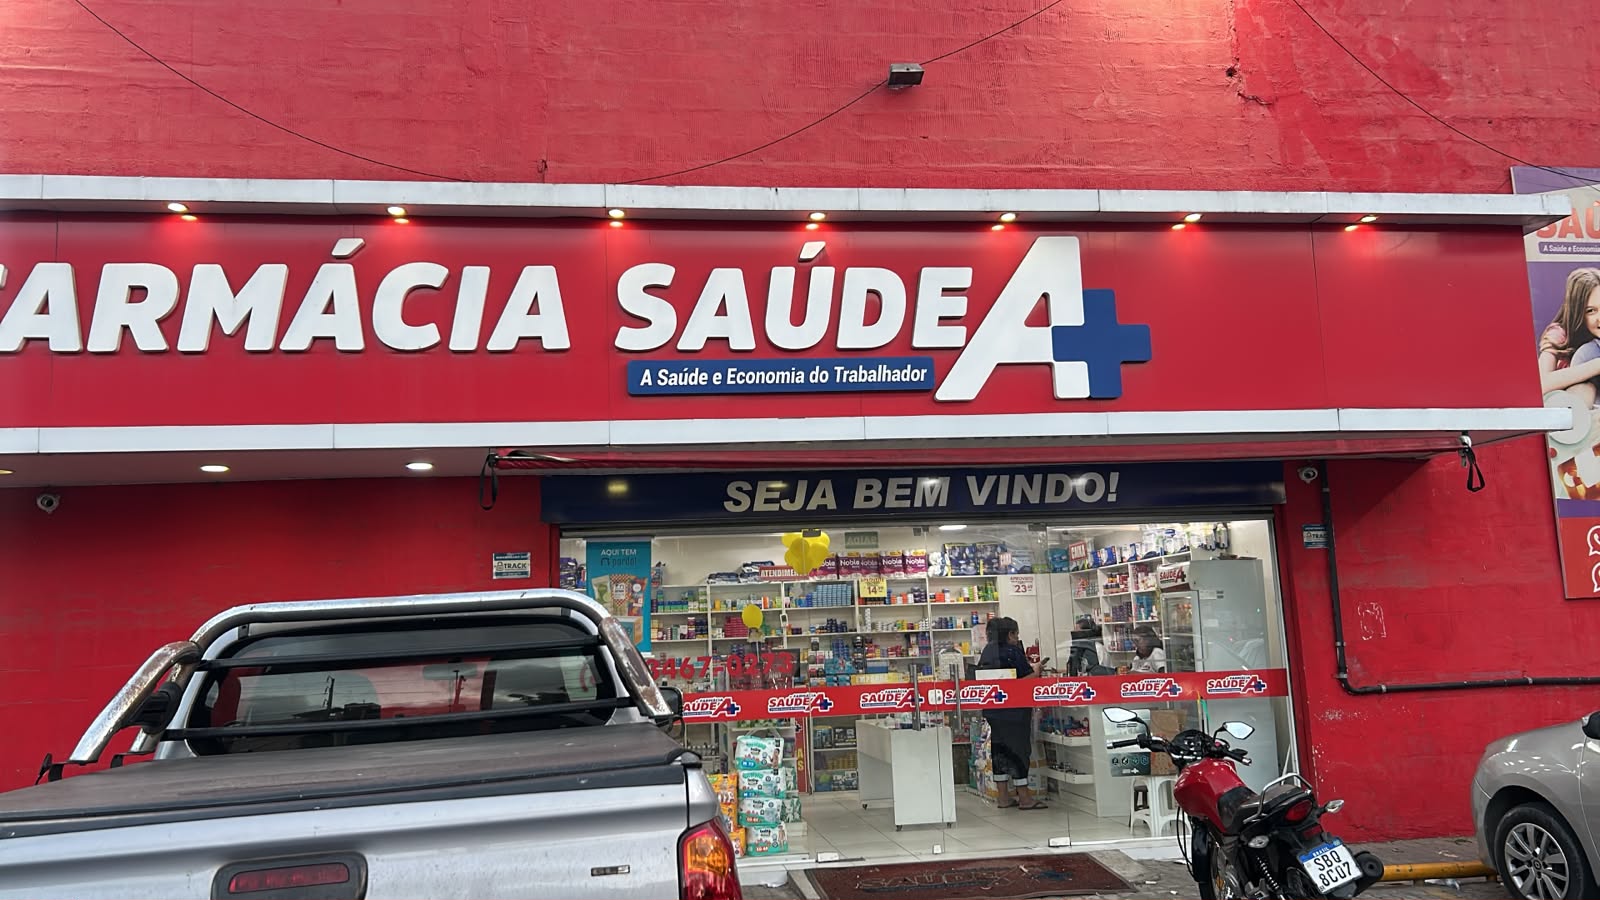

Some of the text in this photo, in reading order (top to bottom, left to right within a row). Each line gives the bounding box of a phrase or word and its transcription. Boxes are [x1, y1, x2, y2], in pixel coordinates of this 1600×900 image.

[0, 237, 571, 352] ARMÁCIA
[614, 241, 973, 351] SAÚDE
[640, 364, 927, 386] A Saúde e Economia do Trabalhador
[723, 472, 1120, 513] SEJA BEM VINDO!
[1014, 584, 1027, 592] 23
[1122, 681, 1160, 692] SAÚDE
[1208, 678, 1246, 688] SAÚDE
[1036, 684, 1073, 696] SAÚDE
[769, 694, 808, 708] SAÚDE
[861, 691, 902, 703] SAÚDE
[684, 701, 716, 711] AÚDE
[1314, 850, 1342, 872] SBQ
[1319, 861, 1352, 886] 8C07
